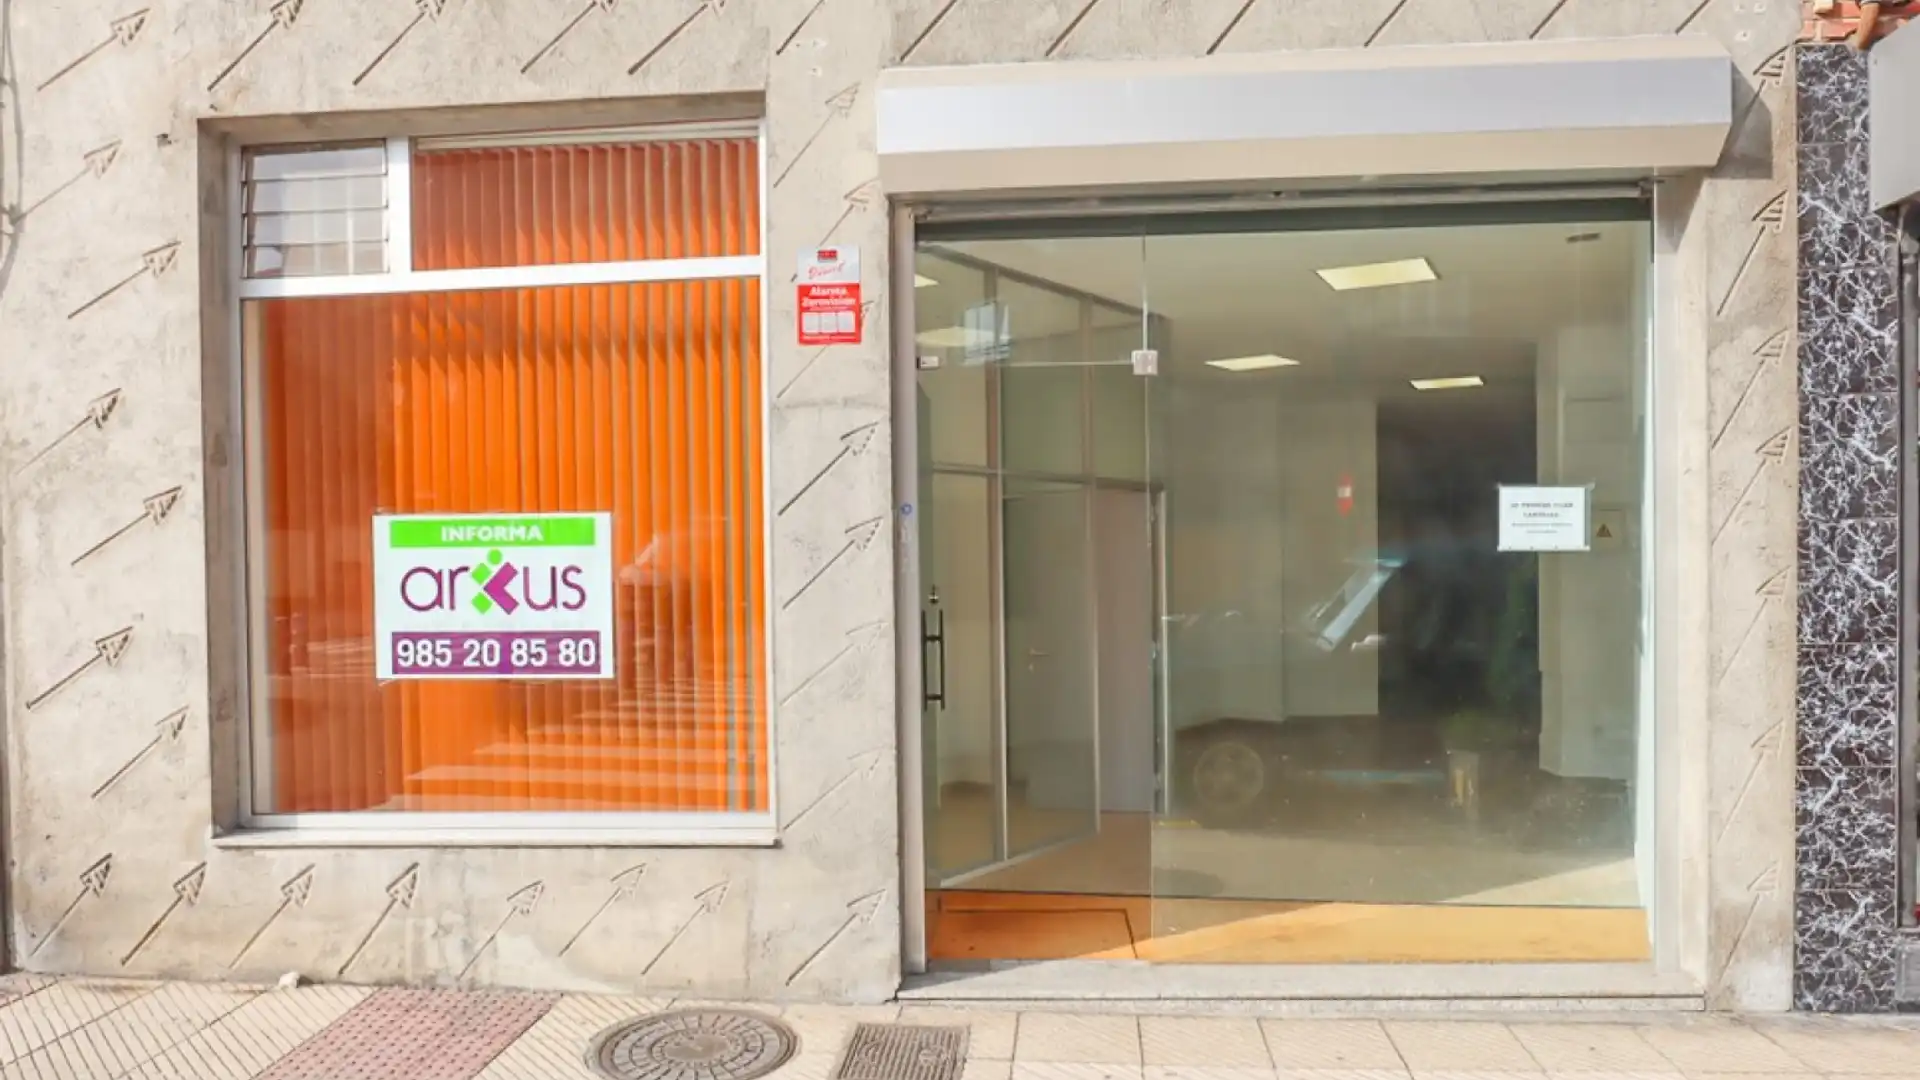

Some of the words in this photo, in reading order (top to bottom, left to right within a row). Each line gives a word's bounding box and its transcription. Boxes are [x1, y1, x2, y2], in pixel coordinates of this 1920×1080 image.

[441, 526, 543, 542] INFORMA
[397, 638, 452, 668] 985
[463, 638, 500, 667] 20
[511, 638, 548, 667] 85
[558, 637, 596, 667] 80
